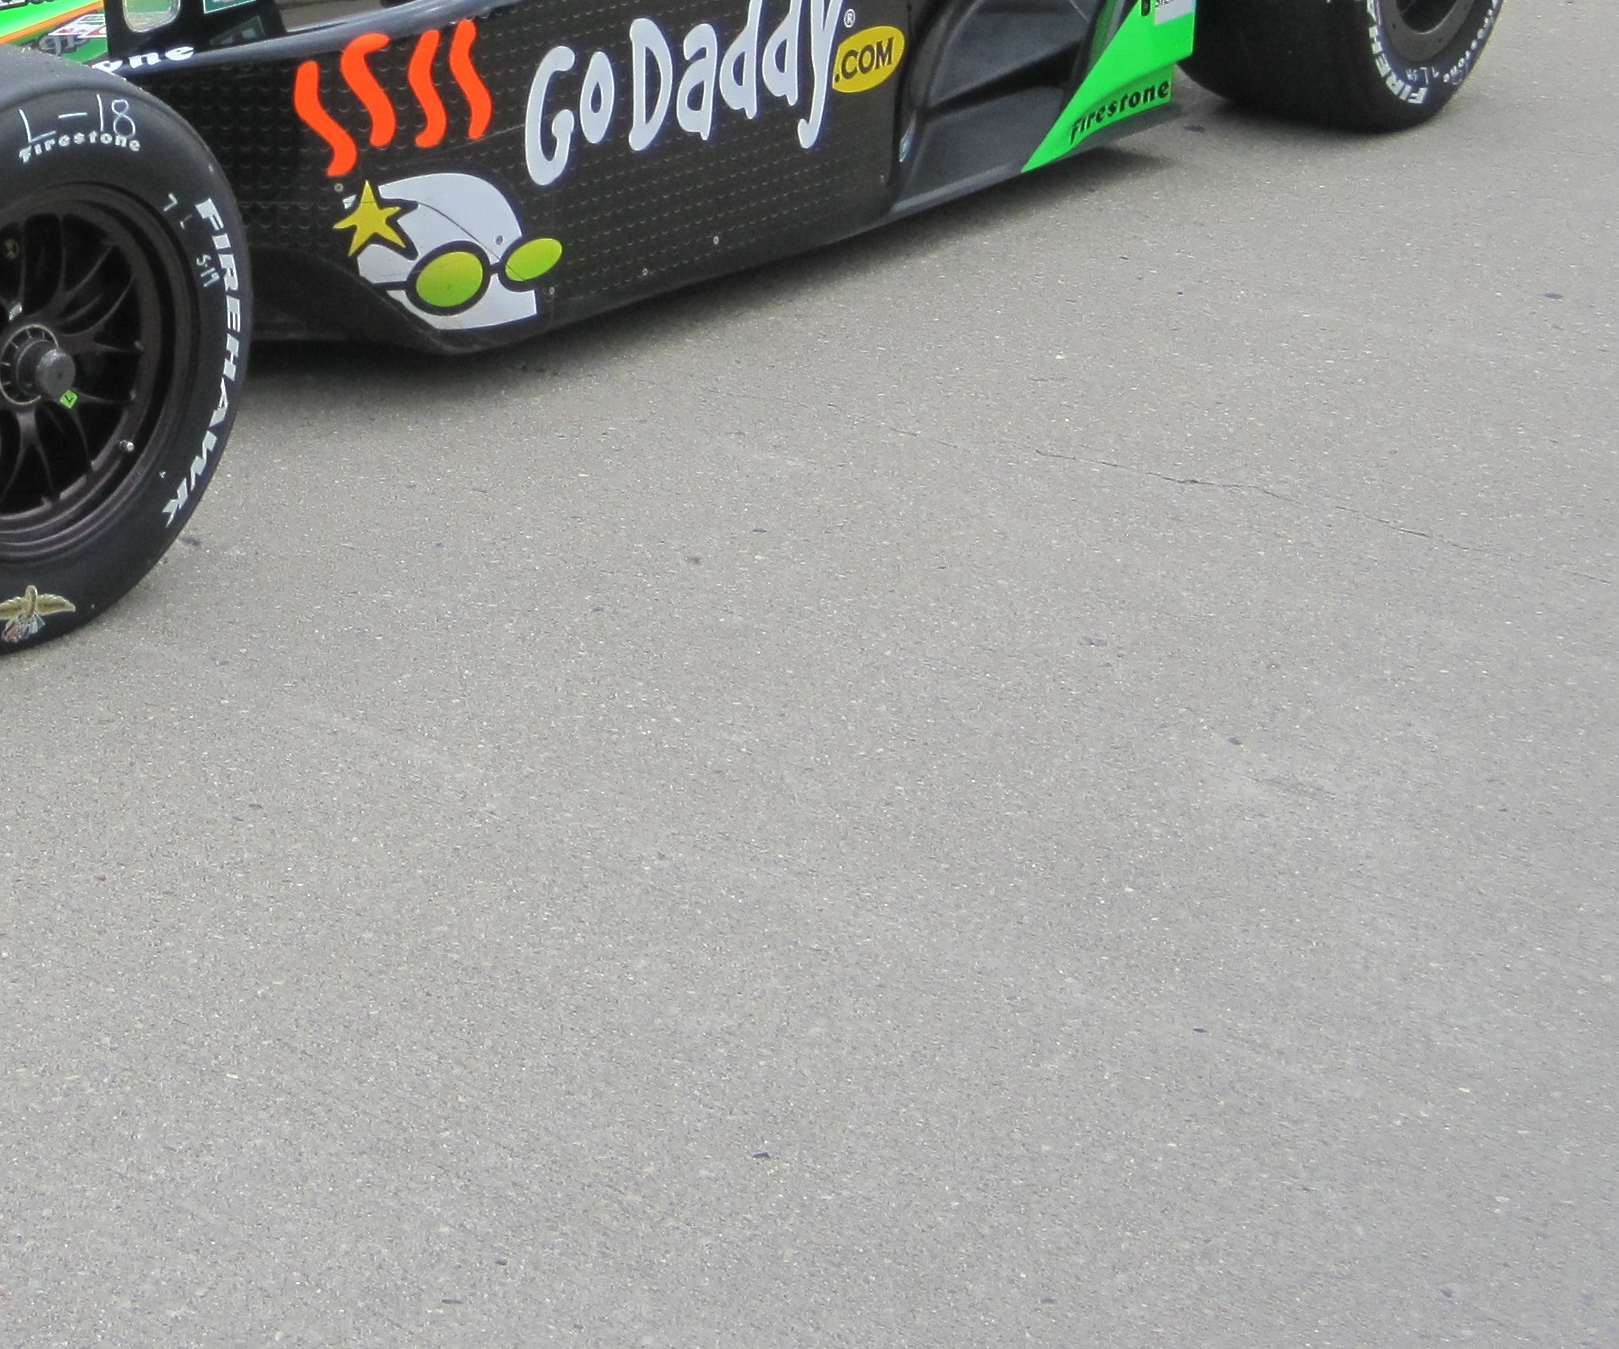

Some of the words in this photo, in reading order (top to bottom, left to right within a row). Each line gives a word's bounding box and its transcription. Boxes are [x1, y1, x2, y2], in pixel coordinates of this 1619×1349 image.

[833, 35, 895, 84] .COM
[1069, 80, 1171, 146] Firestone
[18, 130, 141, 164] Firestone
